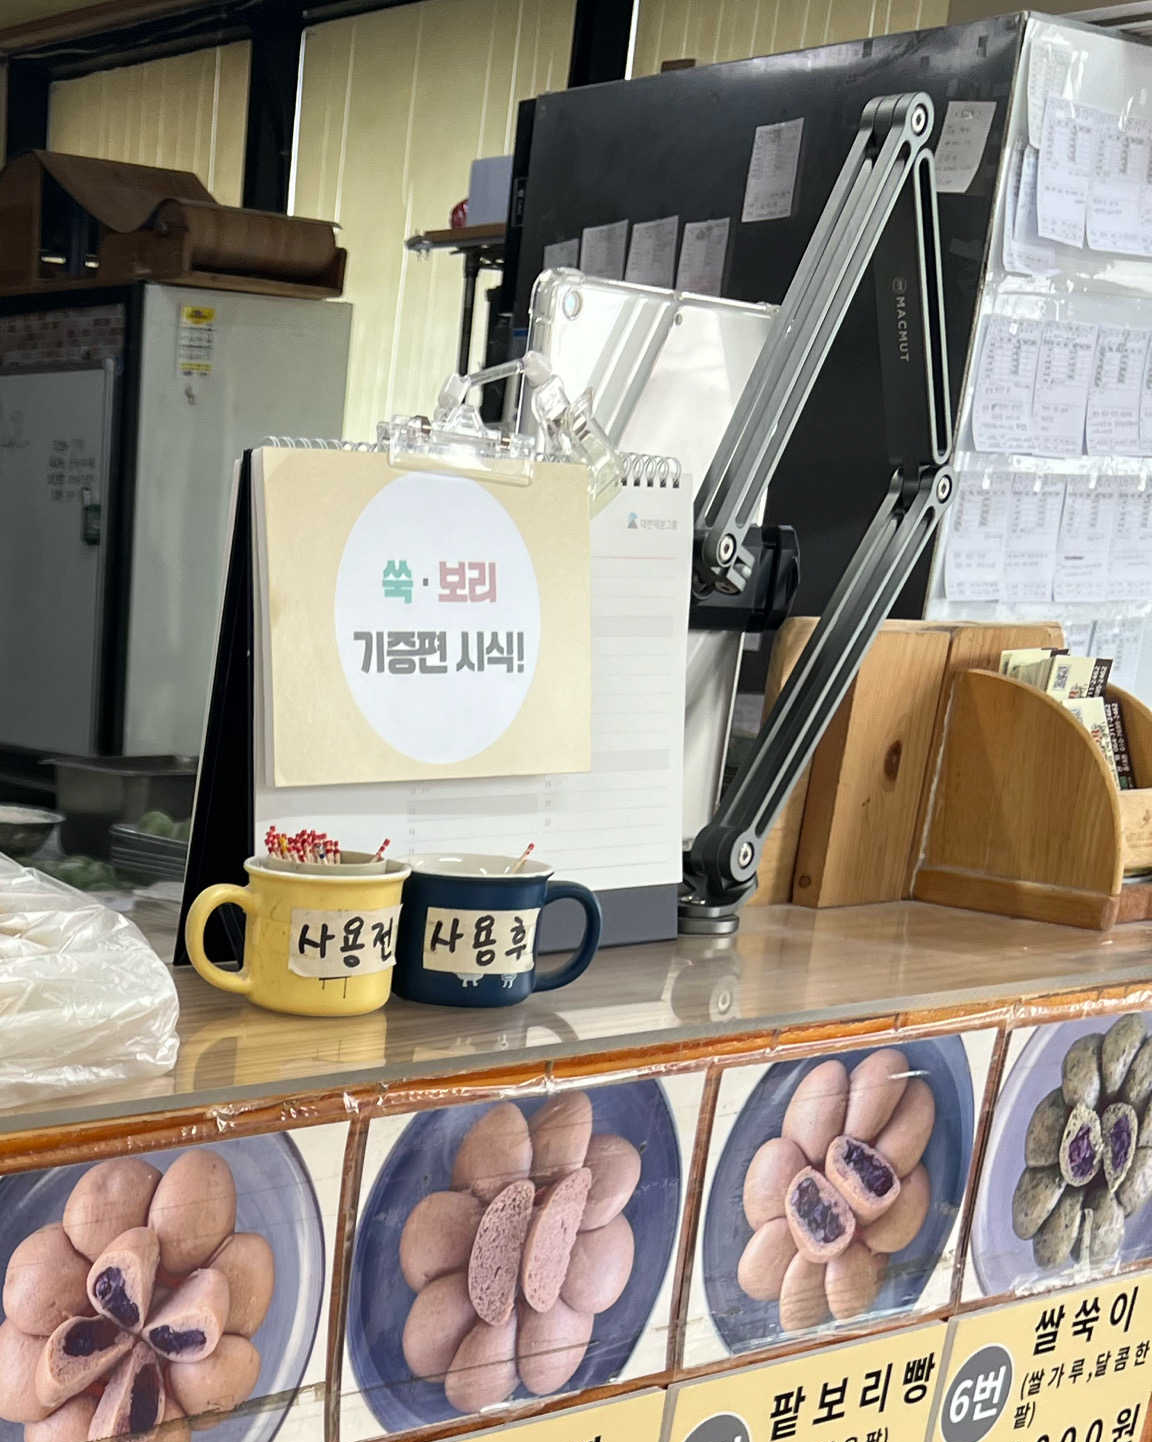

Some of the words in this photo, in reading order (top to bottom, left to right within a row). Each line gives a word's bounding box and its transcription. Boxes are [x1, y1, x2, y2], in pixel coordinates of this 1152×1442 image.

[896, 297, 909, 362] MACMUT
[353, 631, 448, 674] 기증편
[455, 631, 524, 674] 시식!
[949, 1365, 1007, 1424] 6번
[1013, 1401, 1036, 1430] 팥)
